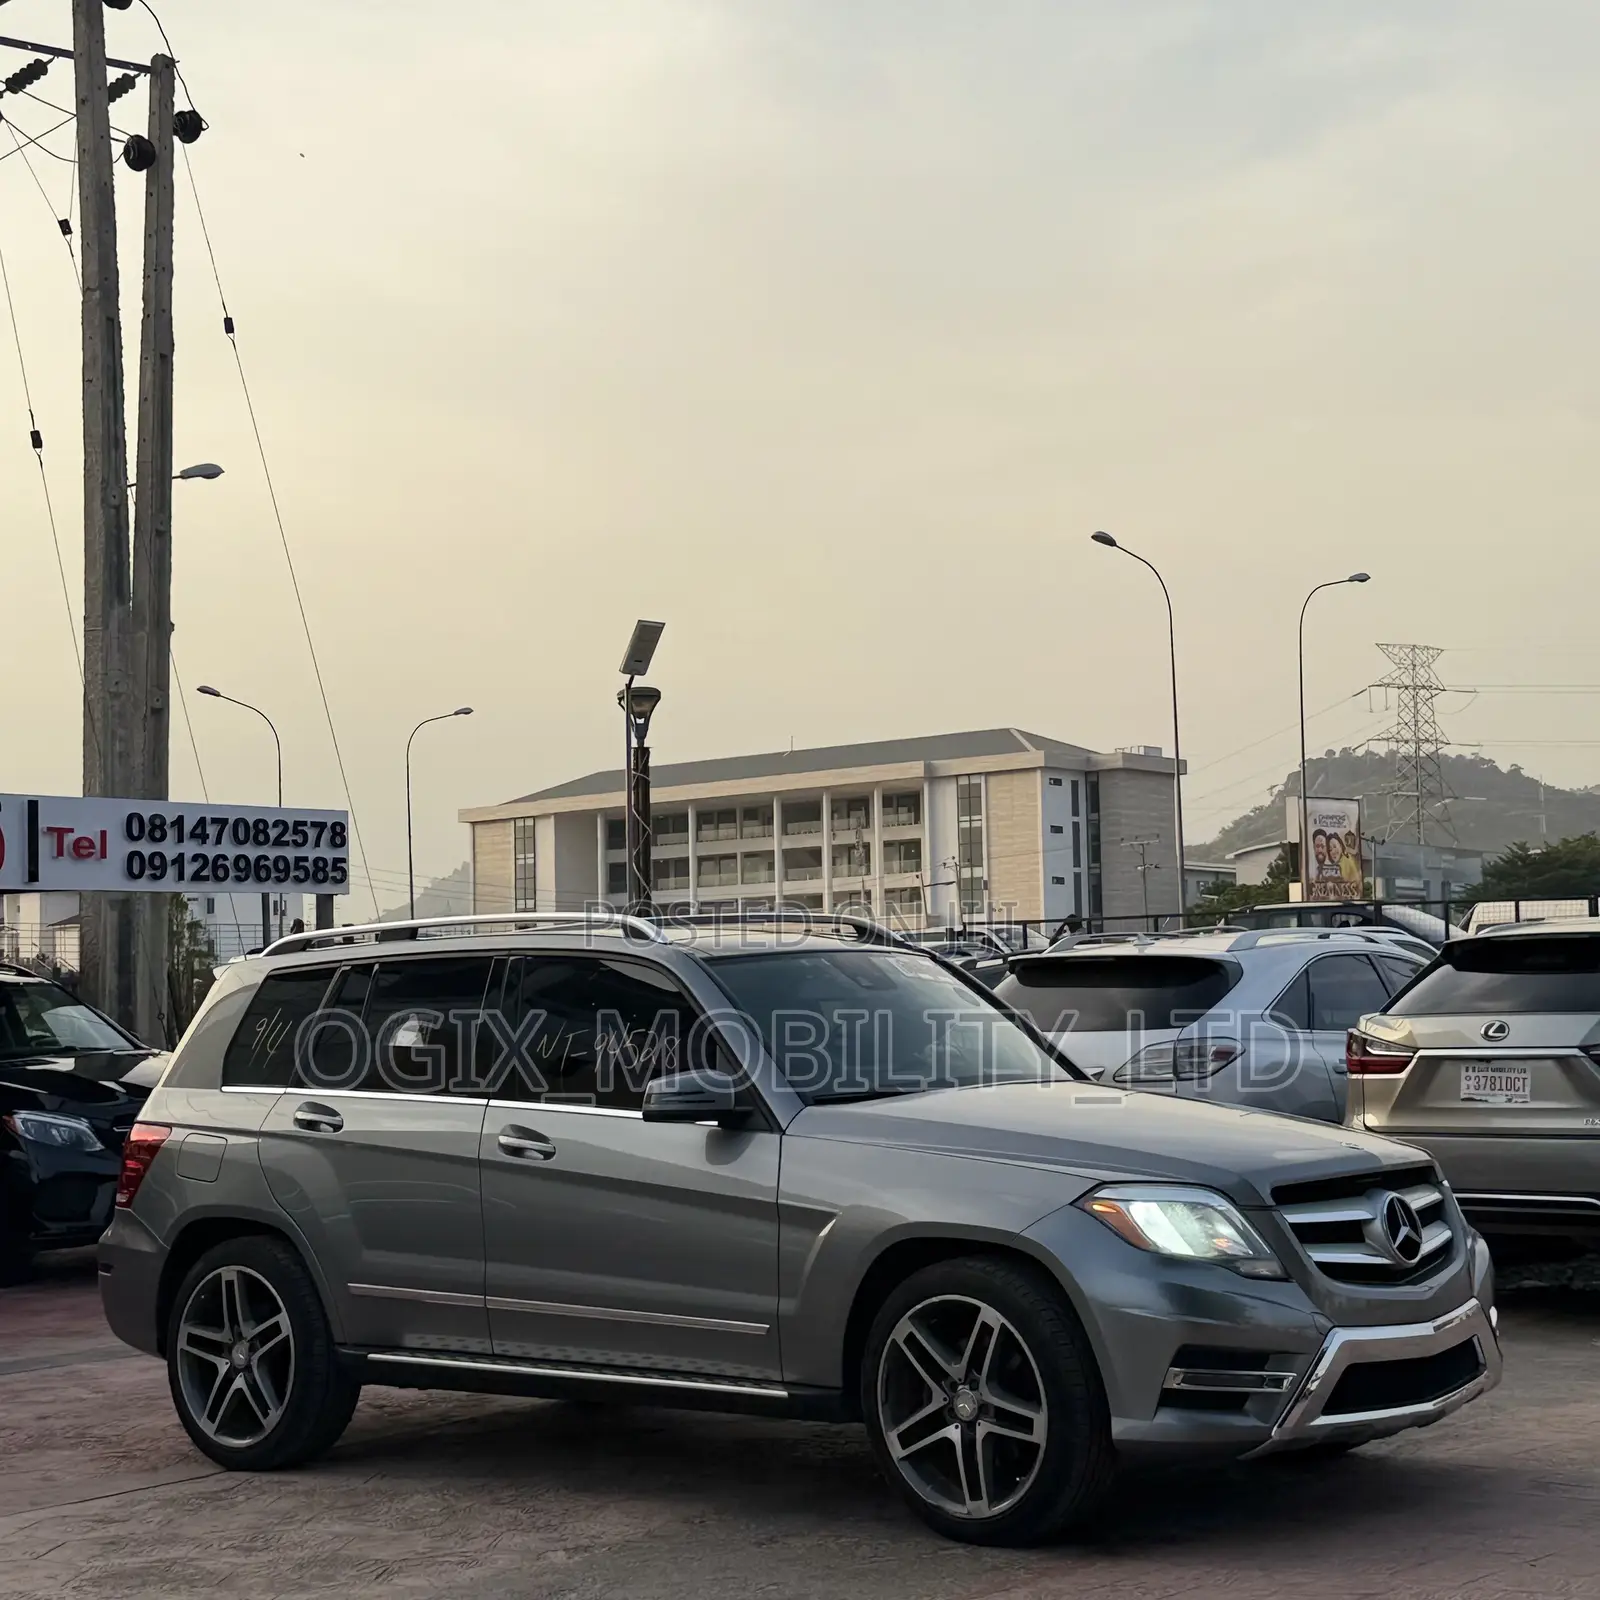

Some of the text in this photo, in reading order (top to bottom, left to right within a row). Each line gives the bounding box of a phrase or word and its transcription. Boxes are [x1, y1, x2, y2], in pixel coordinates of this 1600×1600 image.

[44, 826, 108, 860] Tel
[124, 812, 347, 848] 08147082578
[124, 849, 347, 884] 09126969585
